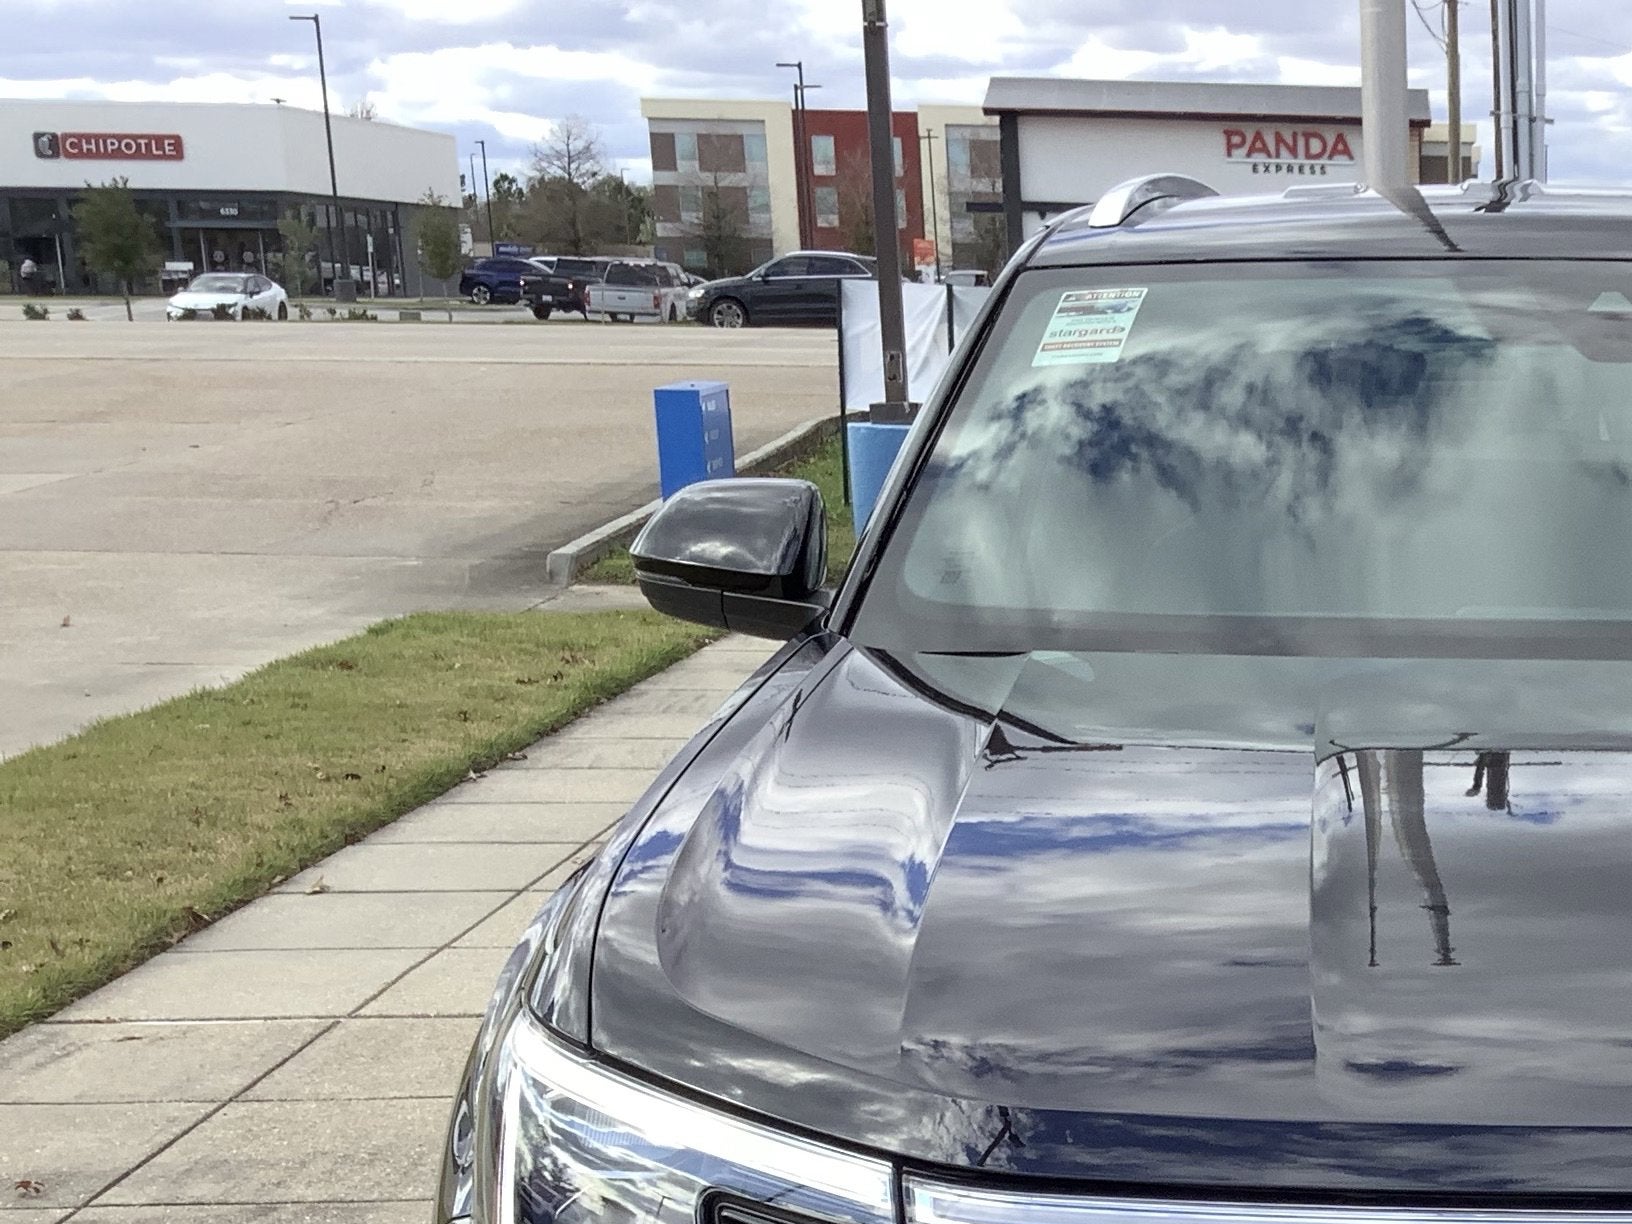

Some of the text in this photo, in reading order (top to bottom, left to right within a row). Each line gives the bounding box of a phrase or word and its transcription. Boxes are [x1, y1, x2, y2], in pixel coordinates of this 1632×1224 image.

[65, 137, 177, 155] CHIPOTLE
[1223, 128, 1355, 161] PANDA
[1251, 162, 1327, 176] EXPRESS
